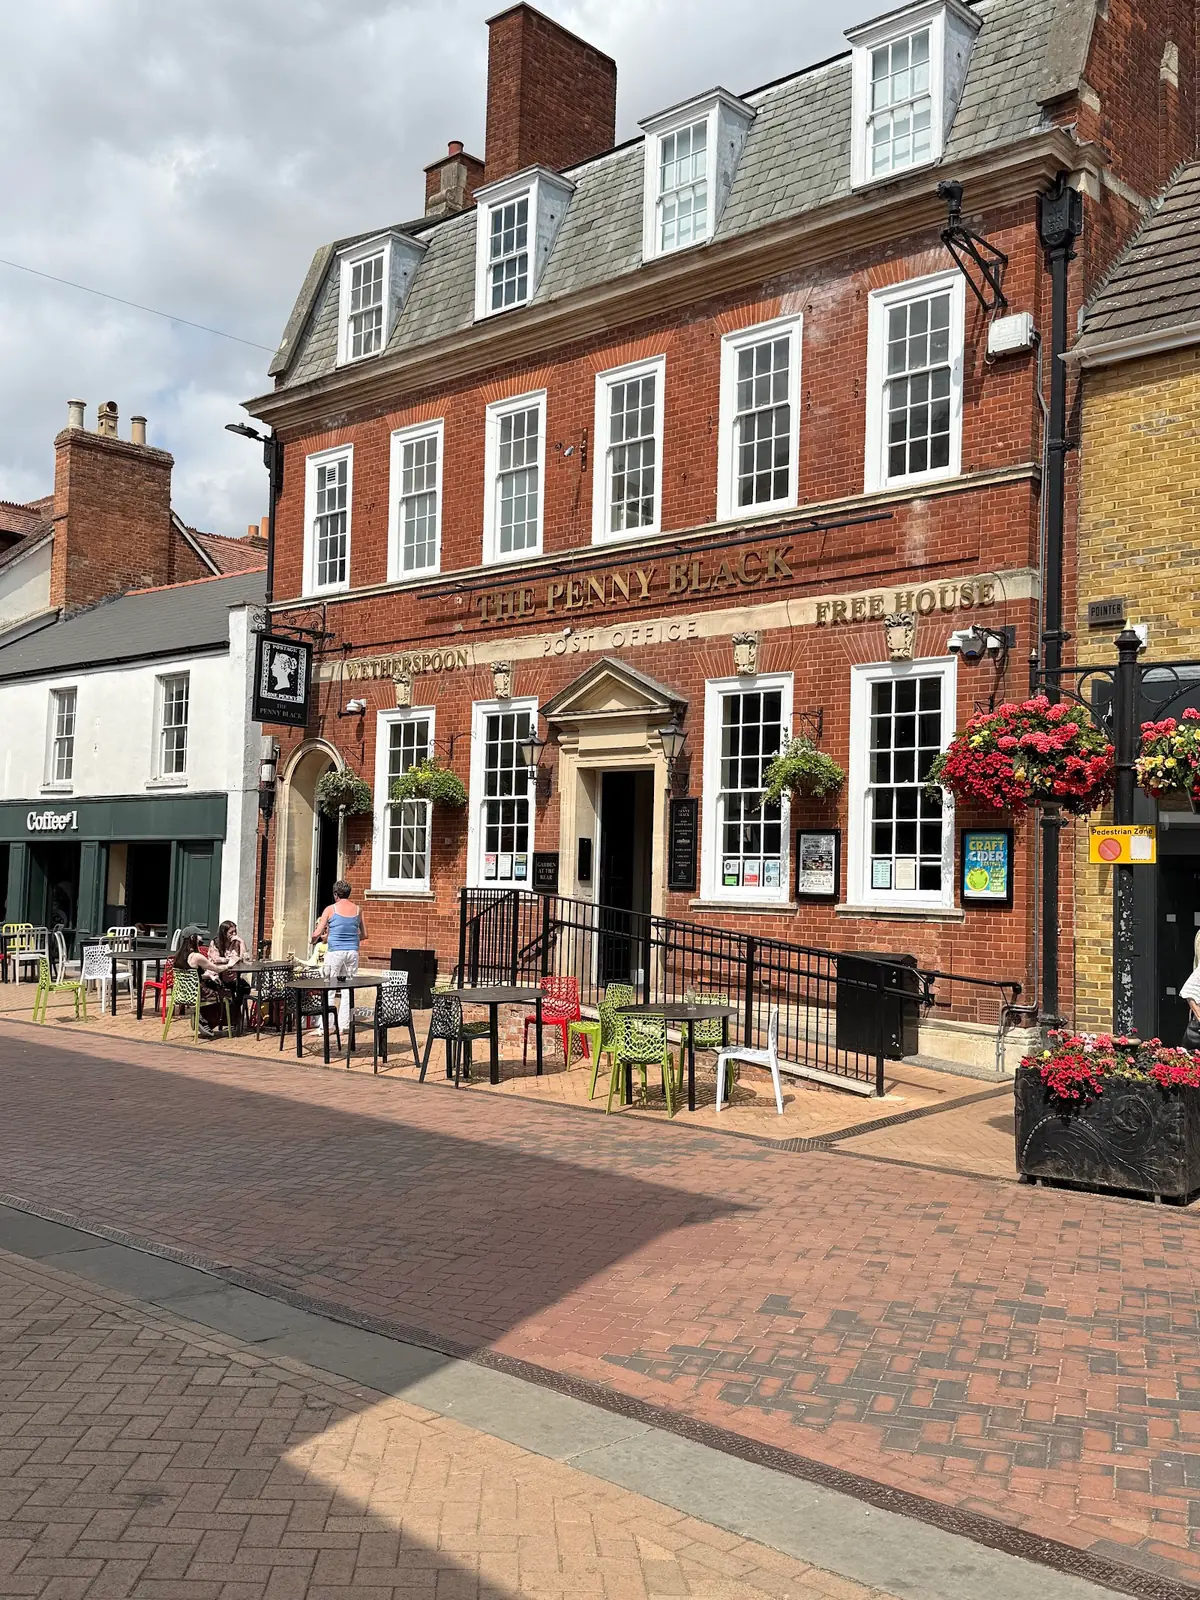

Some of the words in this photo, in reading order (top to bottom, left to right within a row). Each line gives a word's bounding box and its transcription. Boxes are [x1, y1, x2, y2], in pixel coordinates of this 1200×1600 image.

[477, 587, 535, 622] THE
[547, 567, 656, 612] PENNY
[668, 545, 794, 596] BLACK
[815, 595, 884, 627] FREE
[894, 580, 995, 615] HOUSE
[1091, 604, 1121, 616] POINTER
[543, 635, 594, 656] POST
[612, 621, 699, 649] OFFICE
[272, 643, 298, 653] POSTAGE
[346, 649, 469, 680] WETHERSPOON
[260, 707, 281, 717] PENNY
[282, 711, 303, 719] BLACK
[969, 840, 1005, 850] CRAFT
[968, 850, 1004, 861] CIDER
